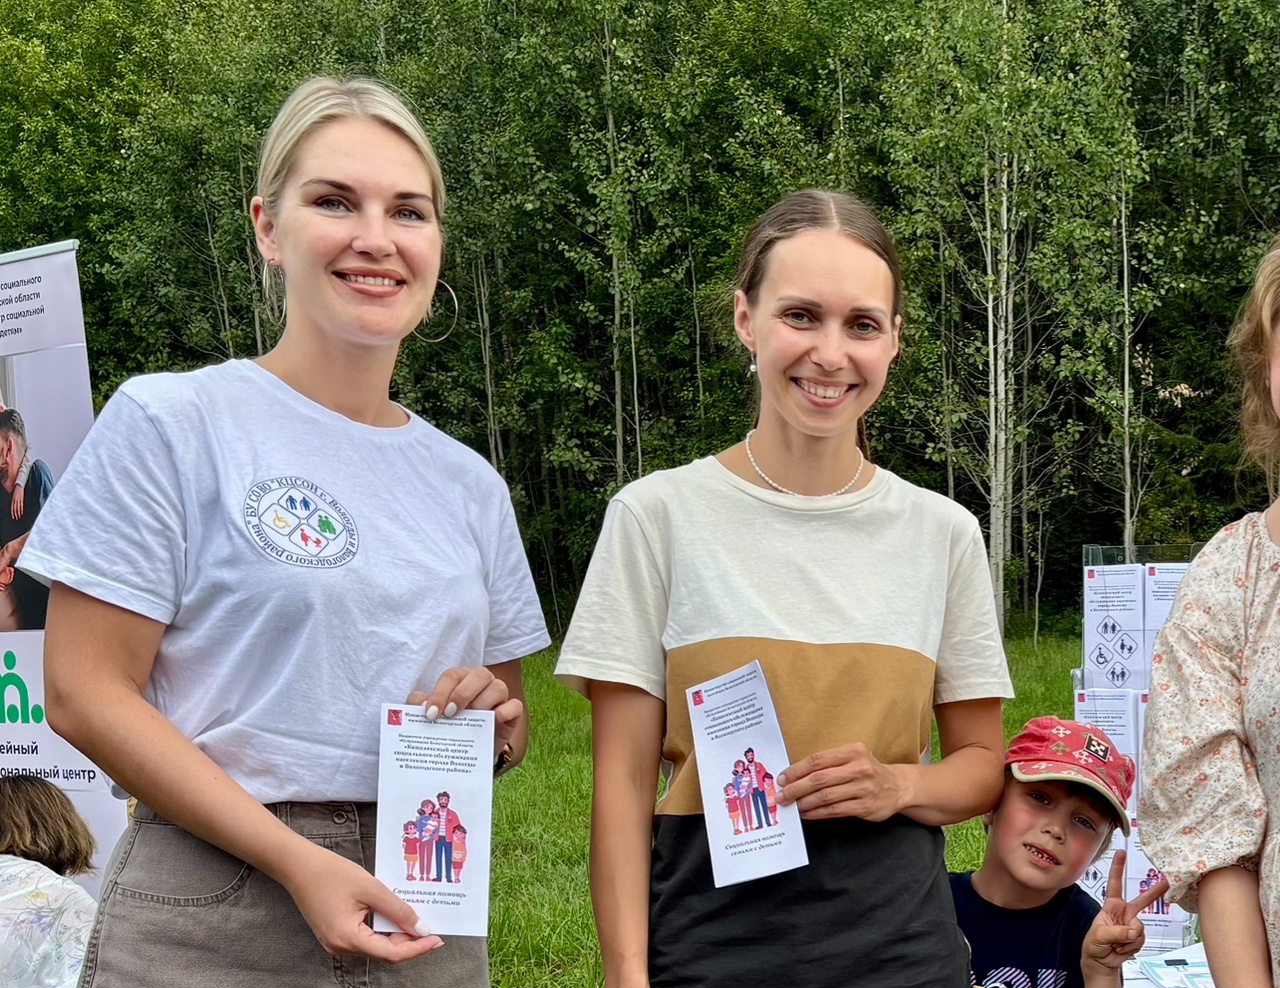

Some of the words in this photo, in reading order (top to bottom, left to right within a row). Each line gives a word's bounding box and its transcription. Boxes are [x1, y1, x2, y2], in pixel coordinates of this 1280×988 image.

[1, 275, 42, 291] социального
[14, 292, 41, 304] области
[6, 304, 45, 321] социальной
[62, 768, 97, 783] центр
